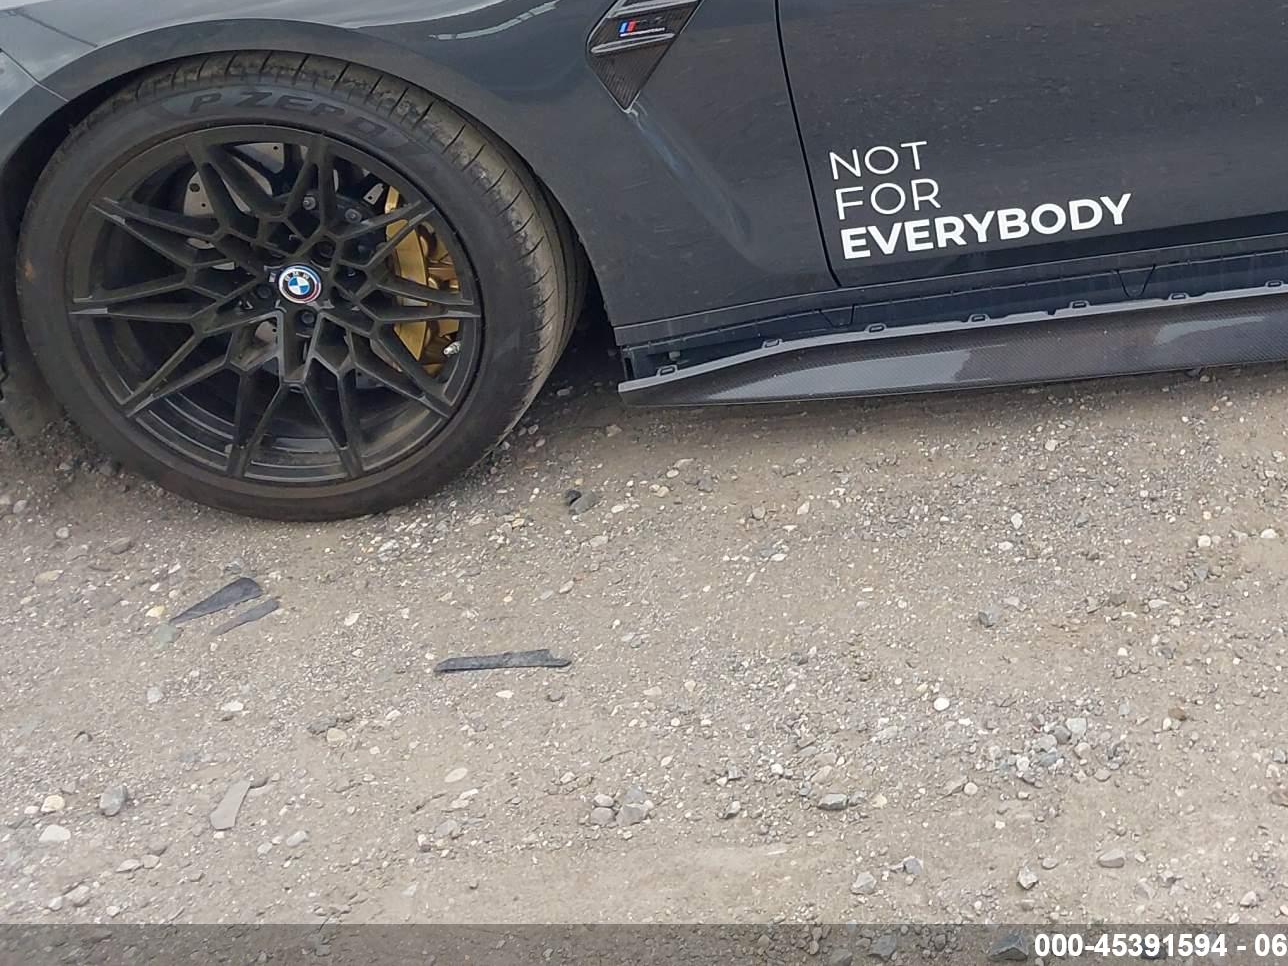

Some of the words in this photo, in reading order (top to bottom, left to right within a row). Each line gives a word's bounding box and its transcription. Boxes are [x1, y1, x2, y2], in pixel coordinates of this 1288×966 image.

[189, 91, 222, 114] P
[828, 140, 929, 181] NOT
[834, 178, 942, 221] FOR
[840, 193, 1133, 261] EVERYBODY
